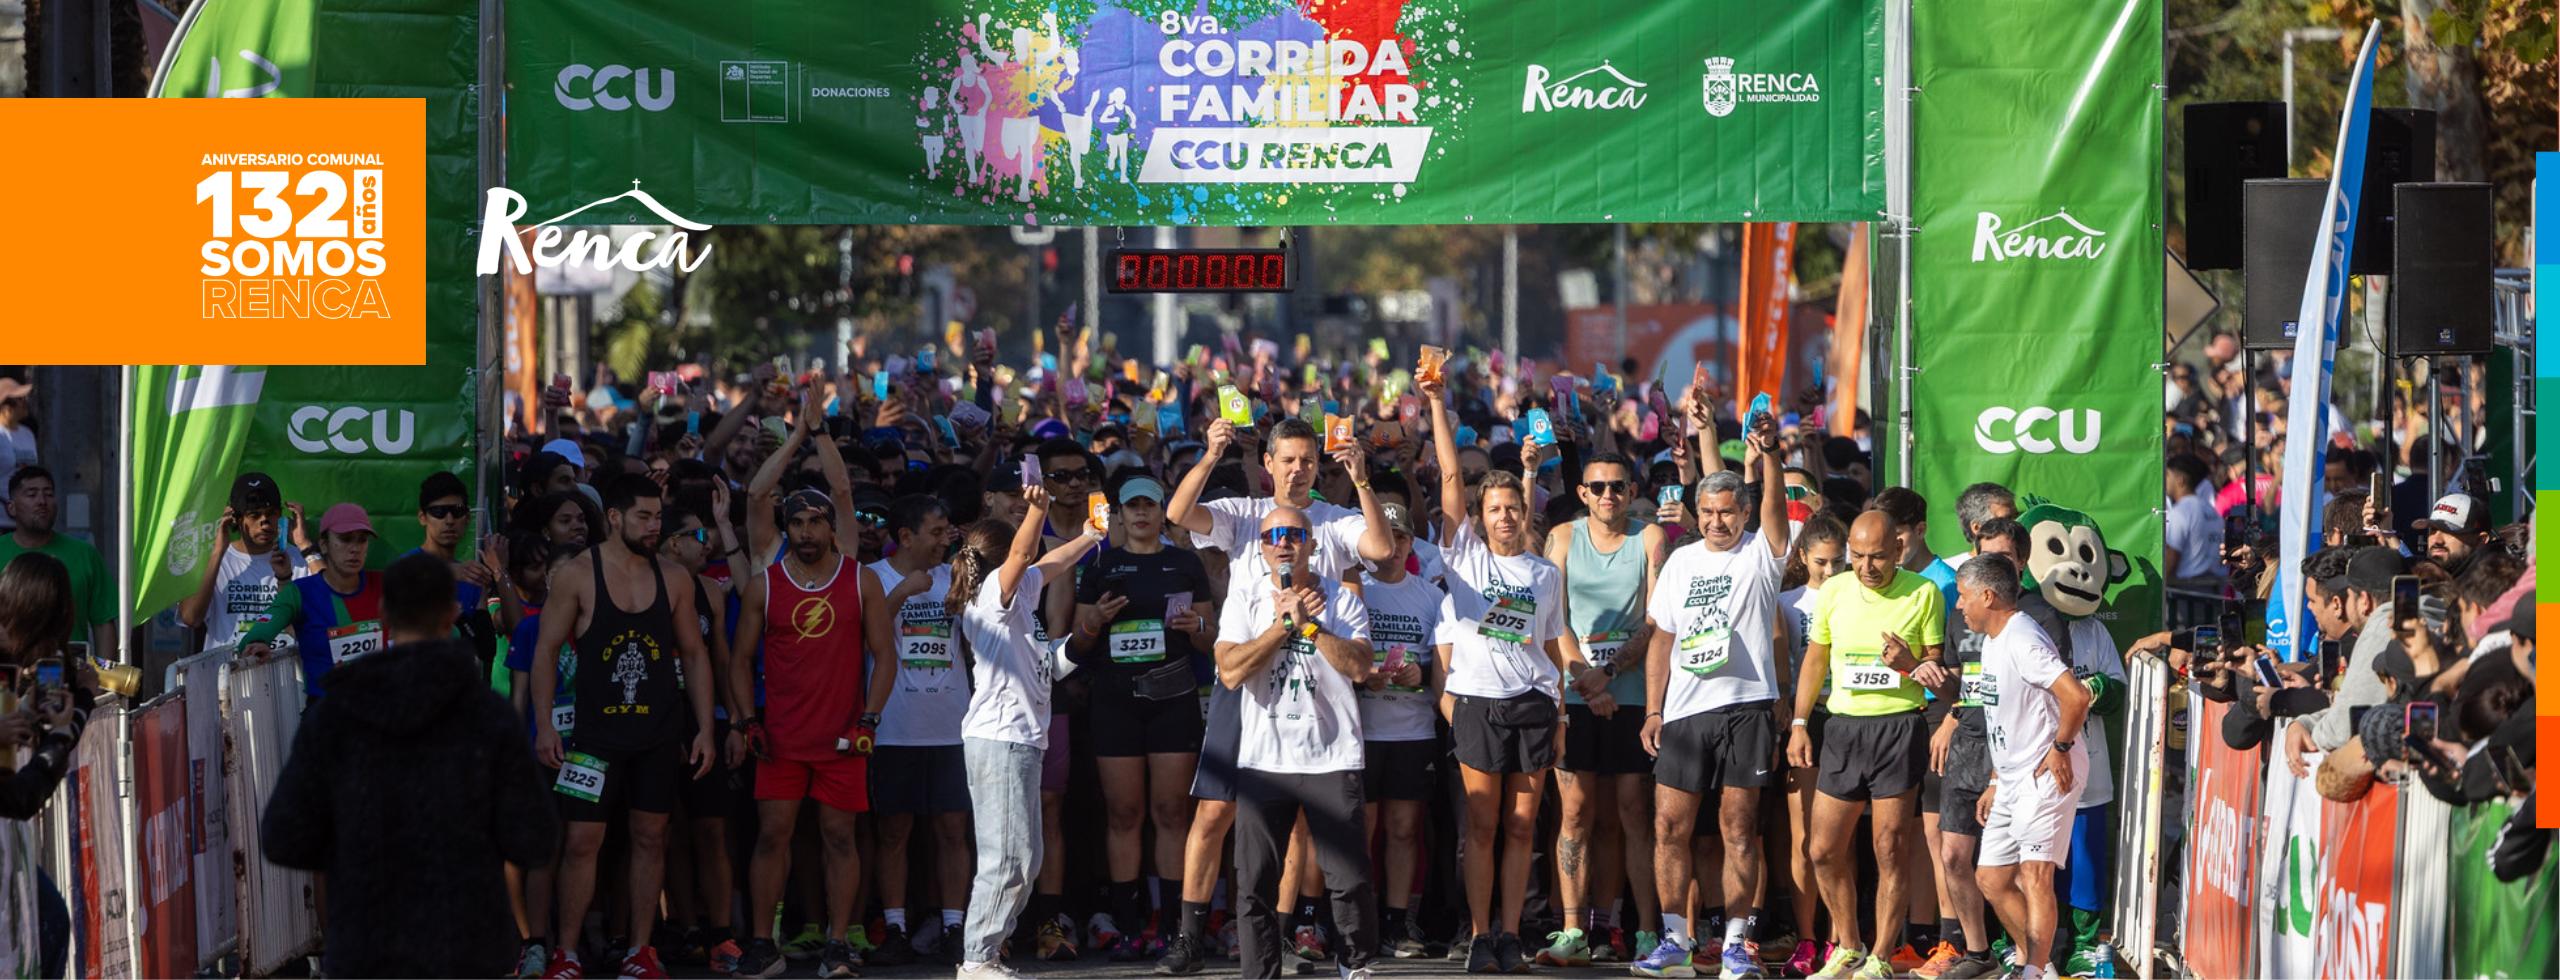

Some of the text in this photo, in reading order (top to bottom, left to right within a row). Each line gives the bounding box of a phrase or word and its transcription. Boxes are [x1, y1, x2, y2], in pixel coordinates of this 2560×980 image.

[1159, 10, 1228, 35] 8va.
[1159, 39, 1410, 77] CORRIDA
[554, 64, 675, 112] CCU
[812, 87, 890, 98] DONACIONES
[1522, 64, 1648, 113] Renca
[1738, 73, 1820, 93] RENCA
[1160, 84, 1420, 122] FAMILIAR
[1738, 94, 1820, 103] I. MUNICIPALIDAD
[1170, 139, 1394, 171] CCU RENCA
[1971, 211, 2106, 264] Renca
[287, 405, 415, 455] CCU
[1974, 405, 2102, 454] CCU
[227, 585, 278, 593] CORRIDA
[1485, 612, 1527, 631] 2075
[1119, 637, 1156, 652] 3231
[1386, 632, 1417, 642] RENCA
[341, 638, 377, 657] 2201
[908, 642, 947, 655] 2095
[1590, 647, 1619, 662] 219
[1689, 646, 1723, 665] 3124
[1852, 672, 1890, 685] 3158
[603, 704, 650, 715] GYM
[563, 768, 598, 789] 3225
